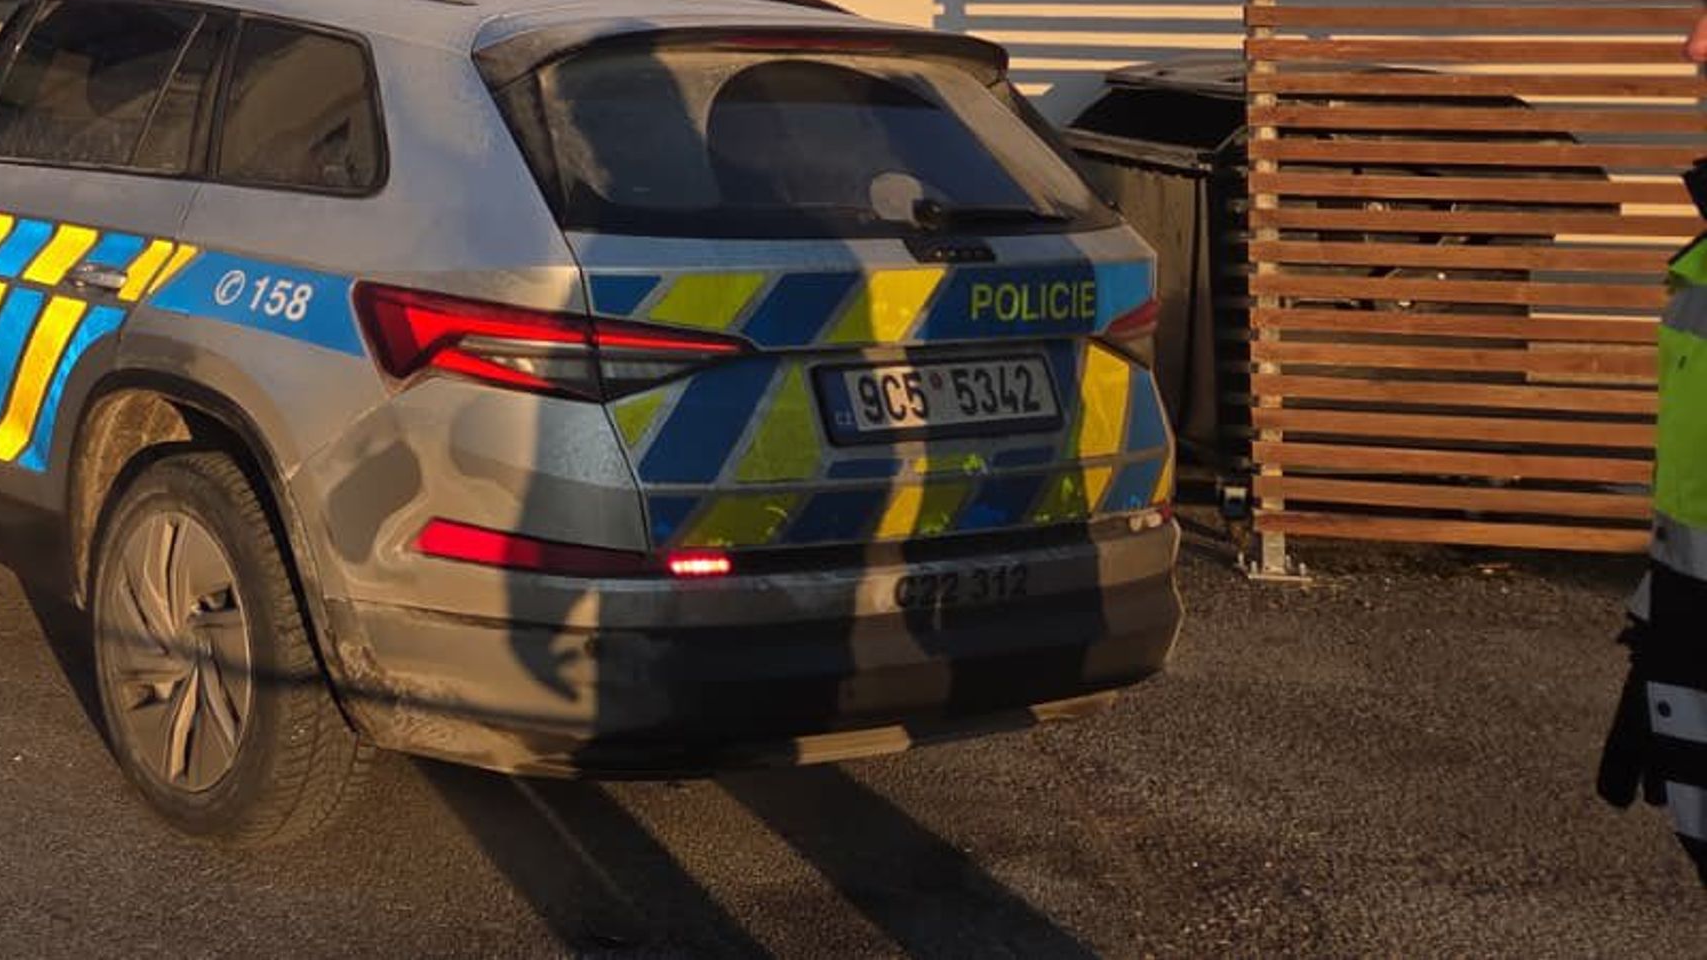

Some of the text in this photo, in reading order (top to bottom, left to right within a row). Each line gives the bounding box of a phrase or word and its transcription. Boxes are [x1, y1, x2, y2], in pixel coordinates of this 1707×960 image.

[250, 276, 313, 321] 158
[971, 280, 1095, 321] POLICIE
[857, 363, 1040, 424] 9C5 5342
[894, 564, 1028, 609] C22 312
